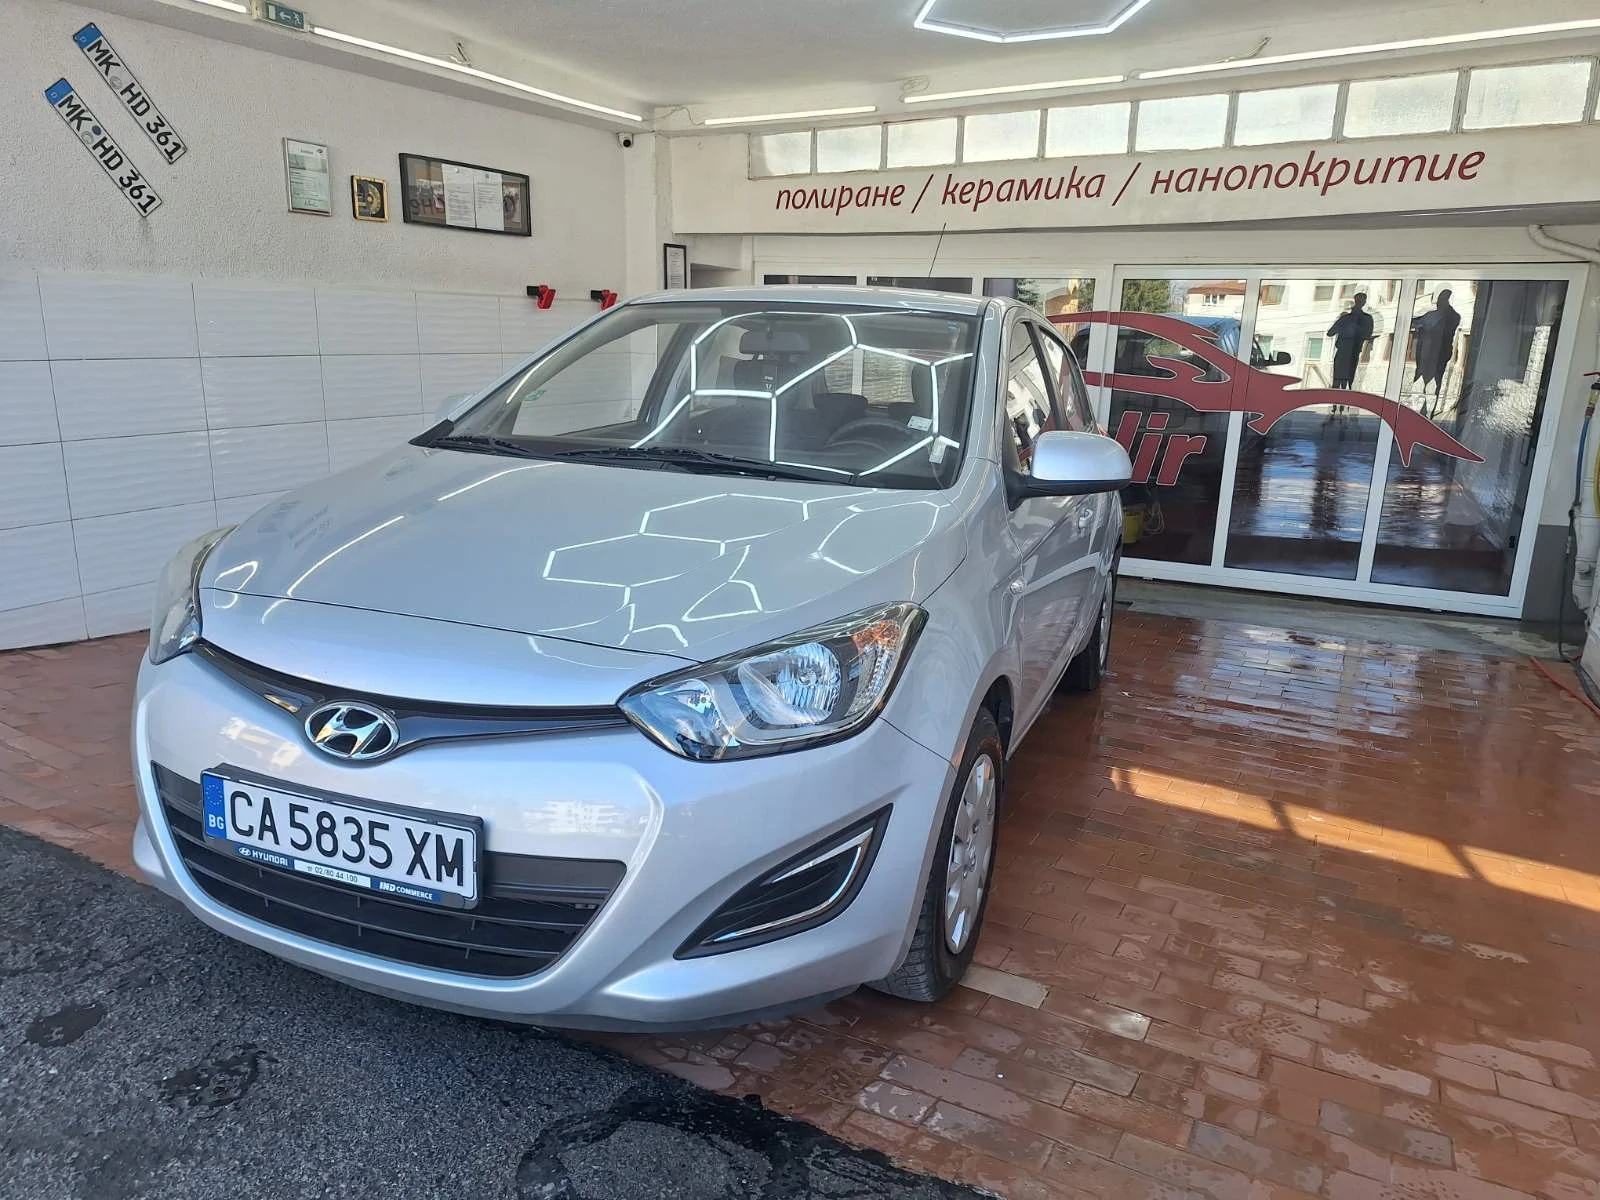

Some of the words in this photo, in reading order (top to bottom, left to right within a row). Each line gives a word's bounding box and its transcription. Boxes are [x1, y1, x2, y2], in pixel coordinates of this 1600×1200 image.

[87, 40, 120, 76] MK
[120, 83, 151, 117] HD
[146, 116, 182, 160] 361
[58, 95, 92, 131] MK
[92, 137, 123, 170] HD
[119, 169, 156, 214] 361
[776, 183, 906, 215] полиране
[942, 166, 1105, 212] керамика
[1150, 151, 1484, 195] нанопокритие
[208, 815, 225, 829] BG
[230, 790, 280, 845] CA
[289, 803, 393, 870] 5835
[405, 828, 464, 886] XM
[252, 850, 288, 866] HYUNDAI
[396, 886, 433, 900] COMMERCE
